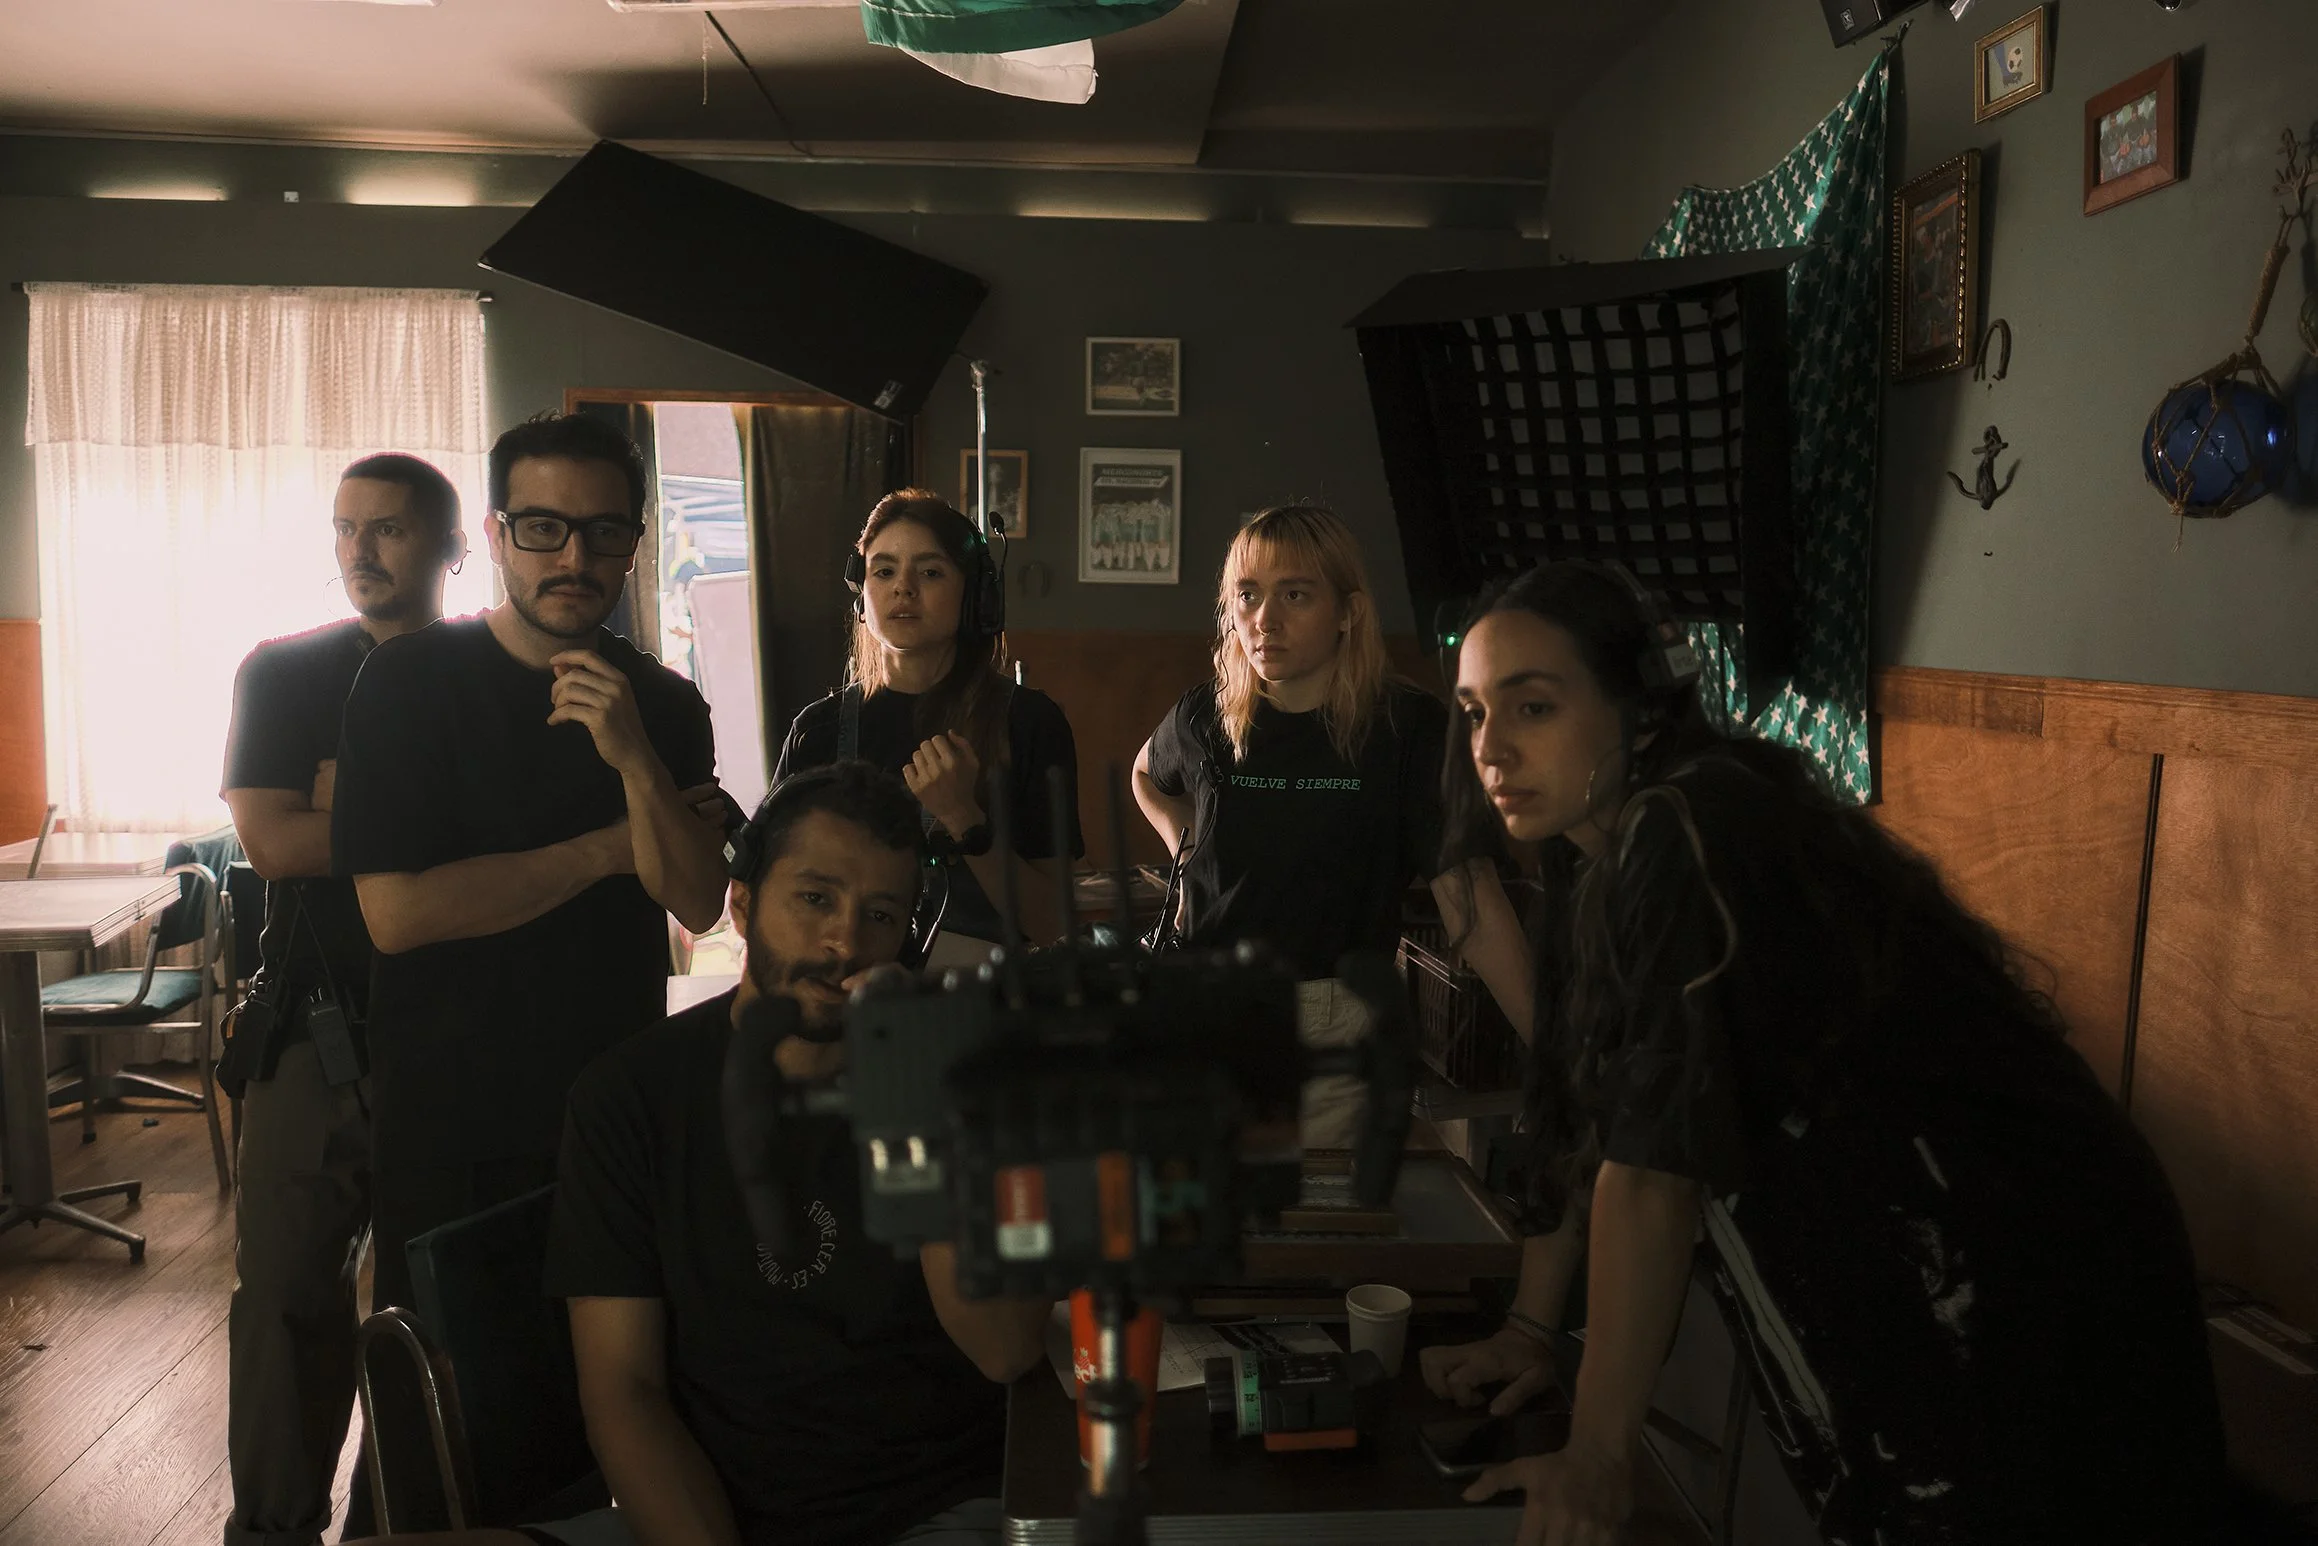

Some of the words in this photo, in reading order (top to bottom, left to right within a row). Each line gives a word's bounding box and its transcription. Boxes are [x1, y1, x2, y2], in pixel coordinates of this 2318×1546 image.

[1230, 775, 1287, 790] VUELVE
[1295, 778, 1361, 791] SIEMPRE
[807, 1200, 837, 1274] FLORECER
[791, 1269, 808, 1290] ES
